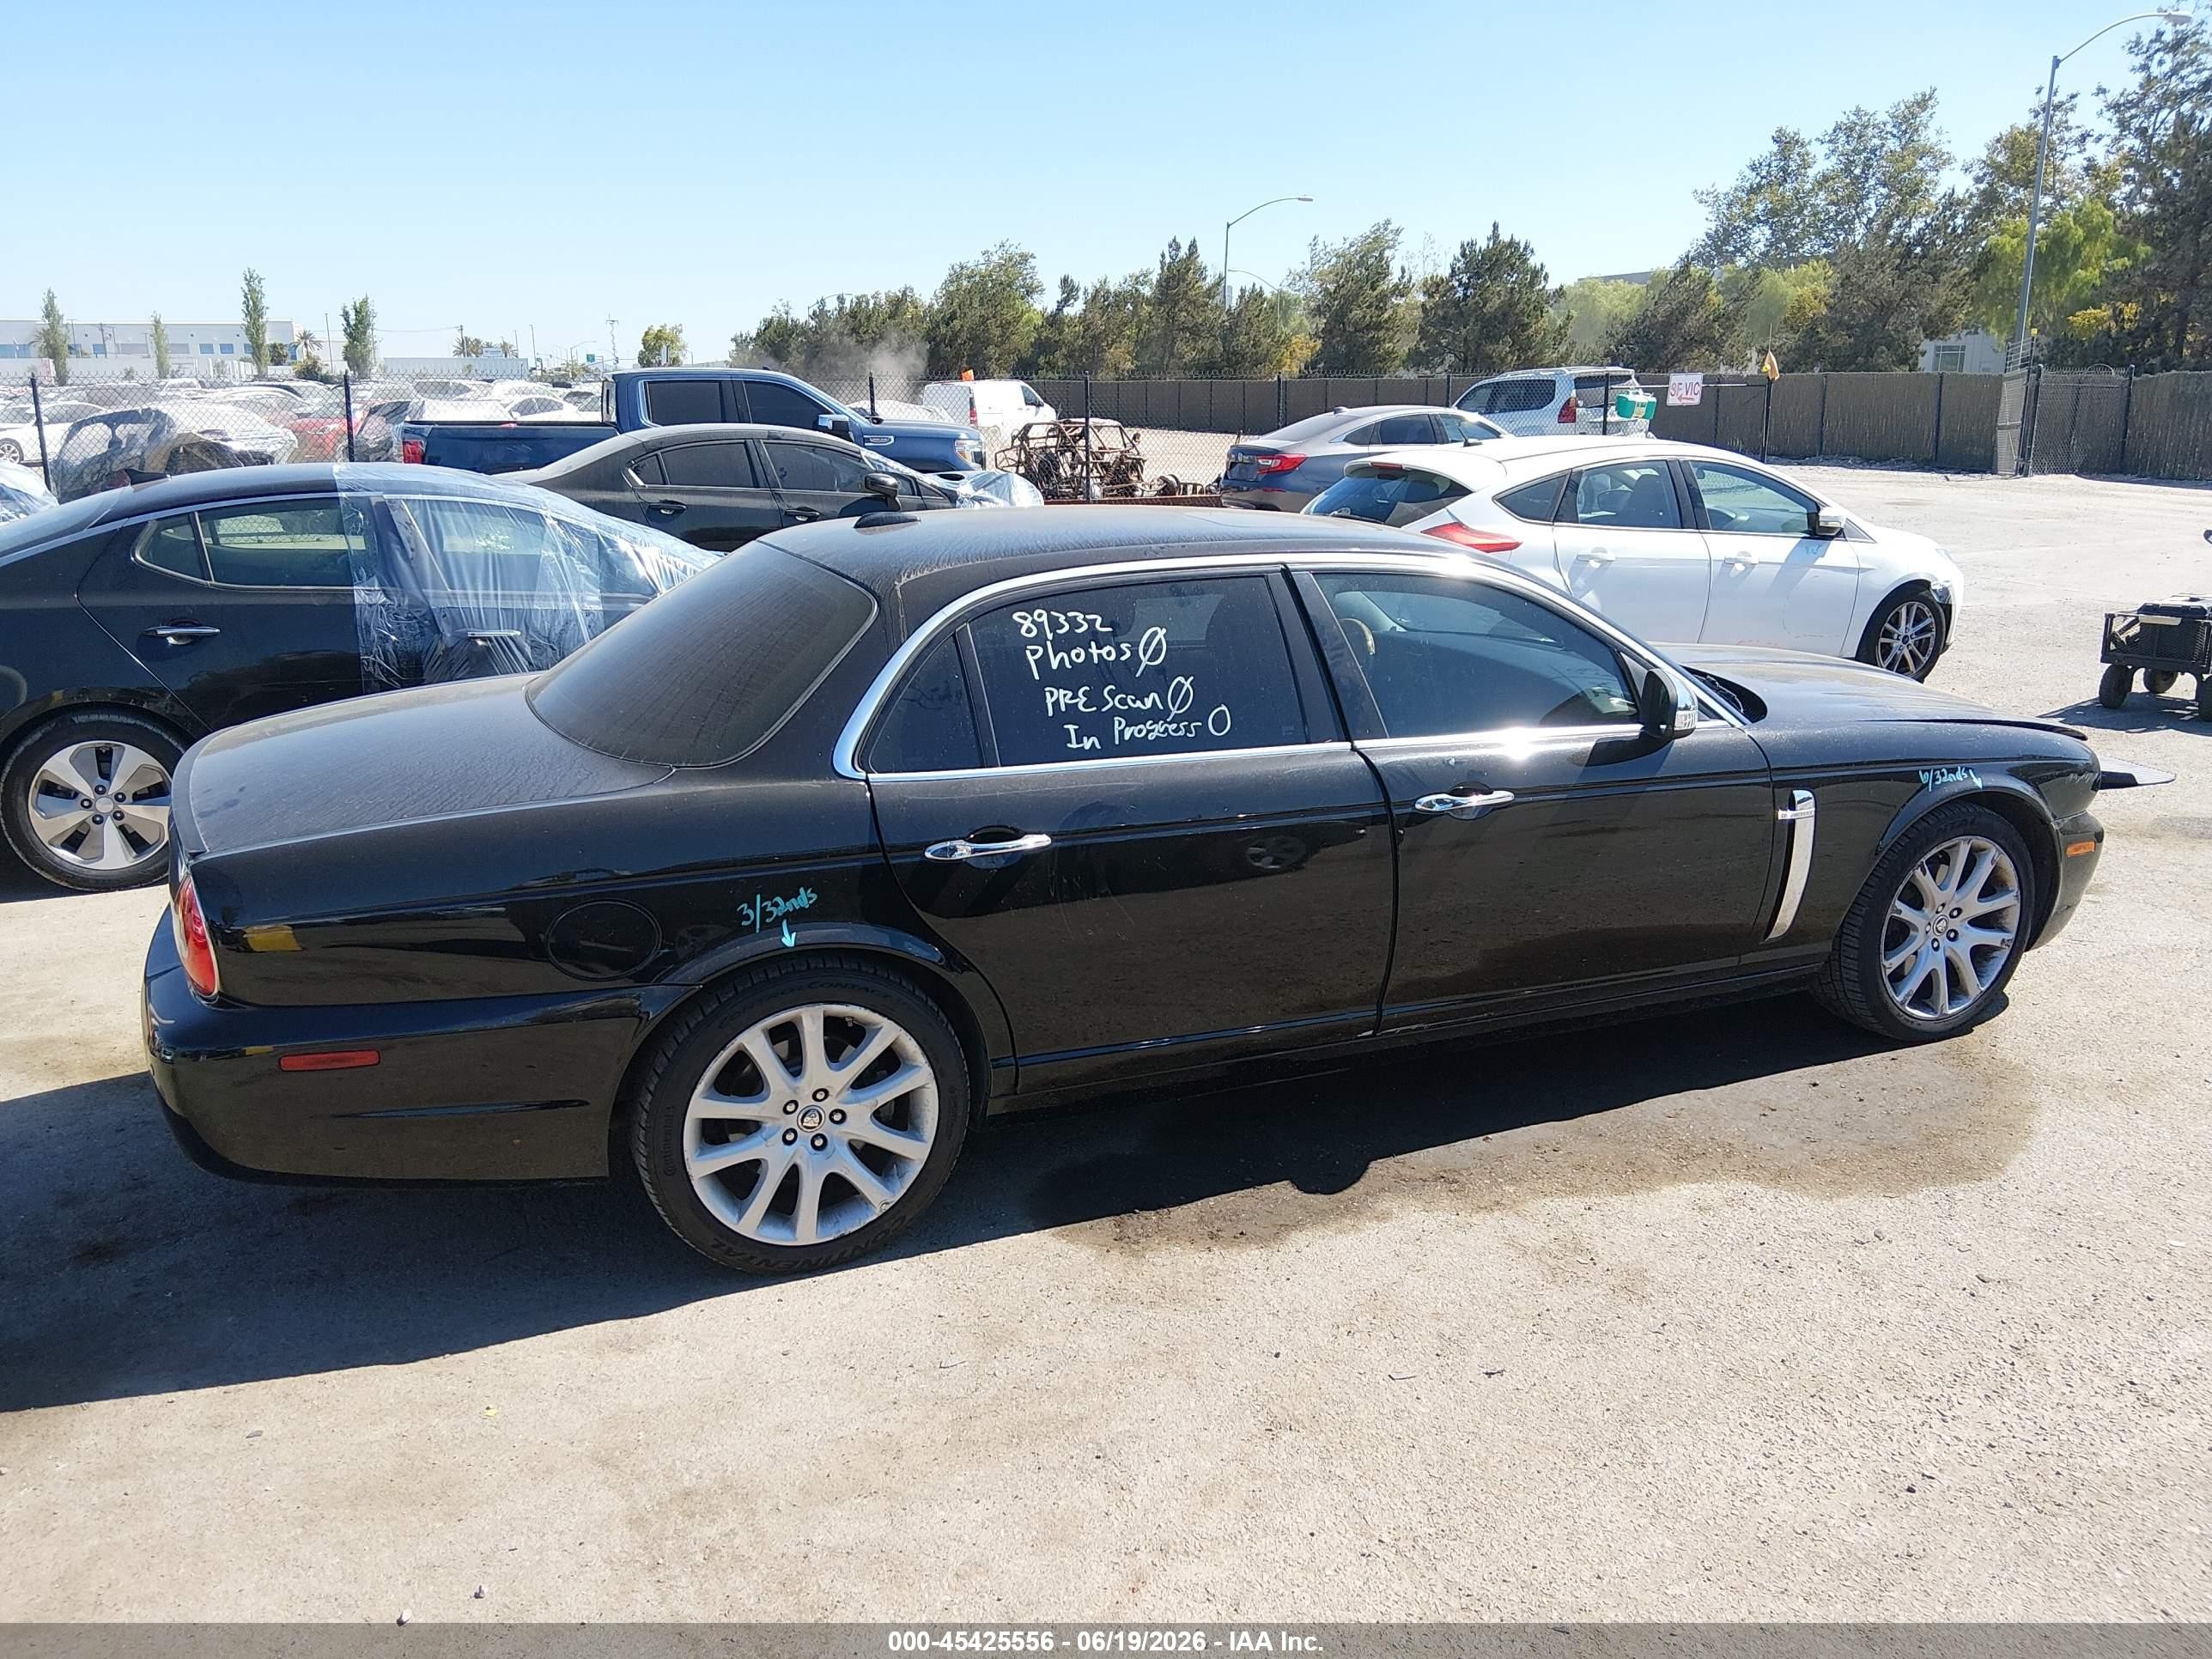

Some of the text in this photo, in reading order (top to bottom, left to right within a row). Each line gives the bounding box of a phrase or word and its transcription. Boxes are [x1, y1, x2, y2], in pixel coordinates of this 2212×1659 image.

[1685, 381, 1700, 396] VIC
[1012, 609, 1113, 641] 89332
[1044, 685, 1164, 717] PRE Scan
[1063, 717, 1203, 750] In Progress
[737, 887, 818, 933] 3/32nds
